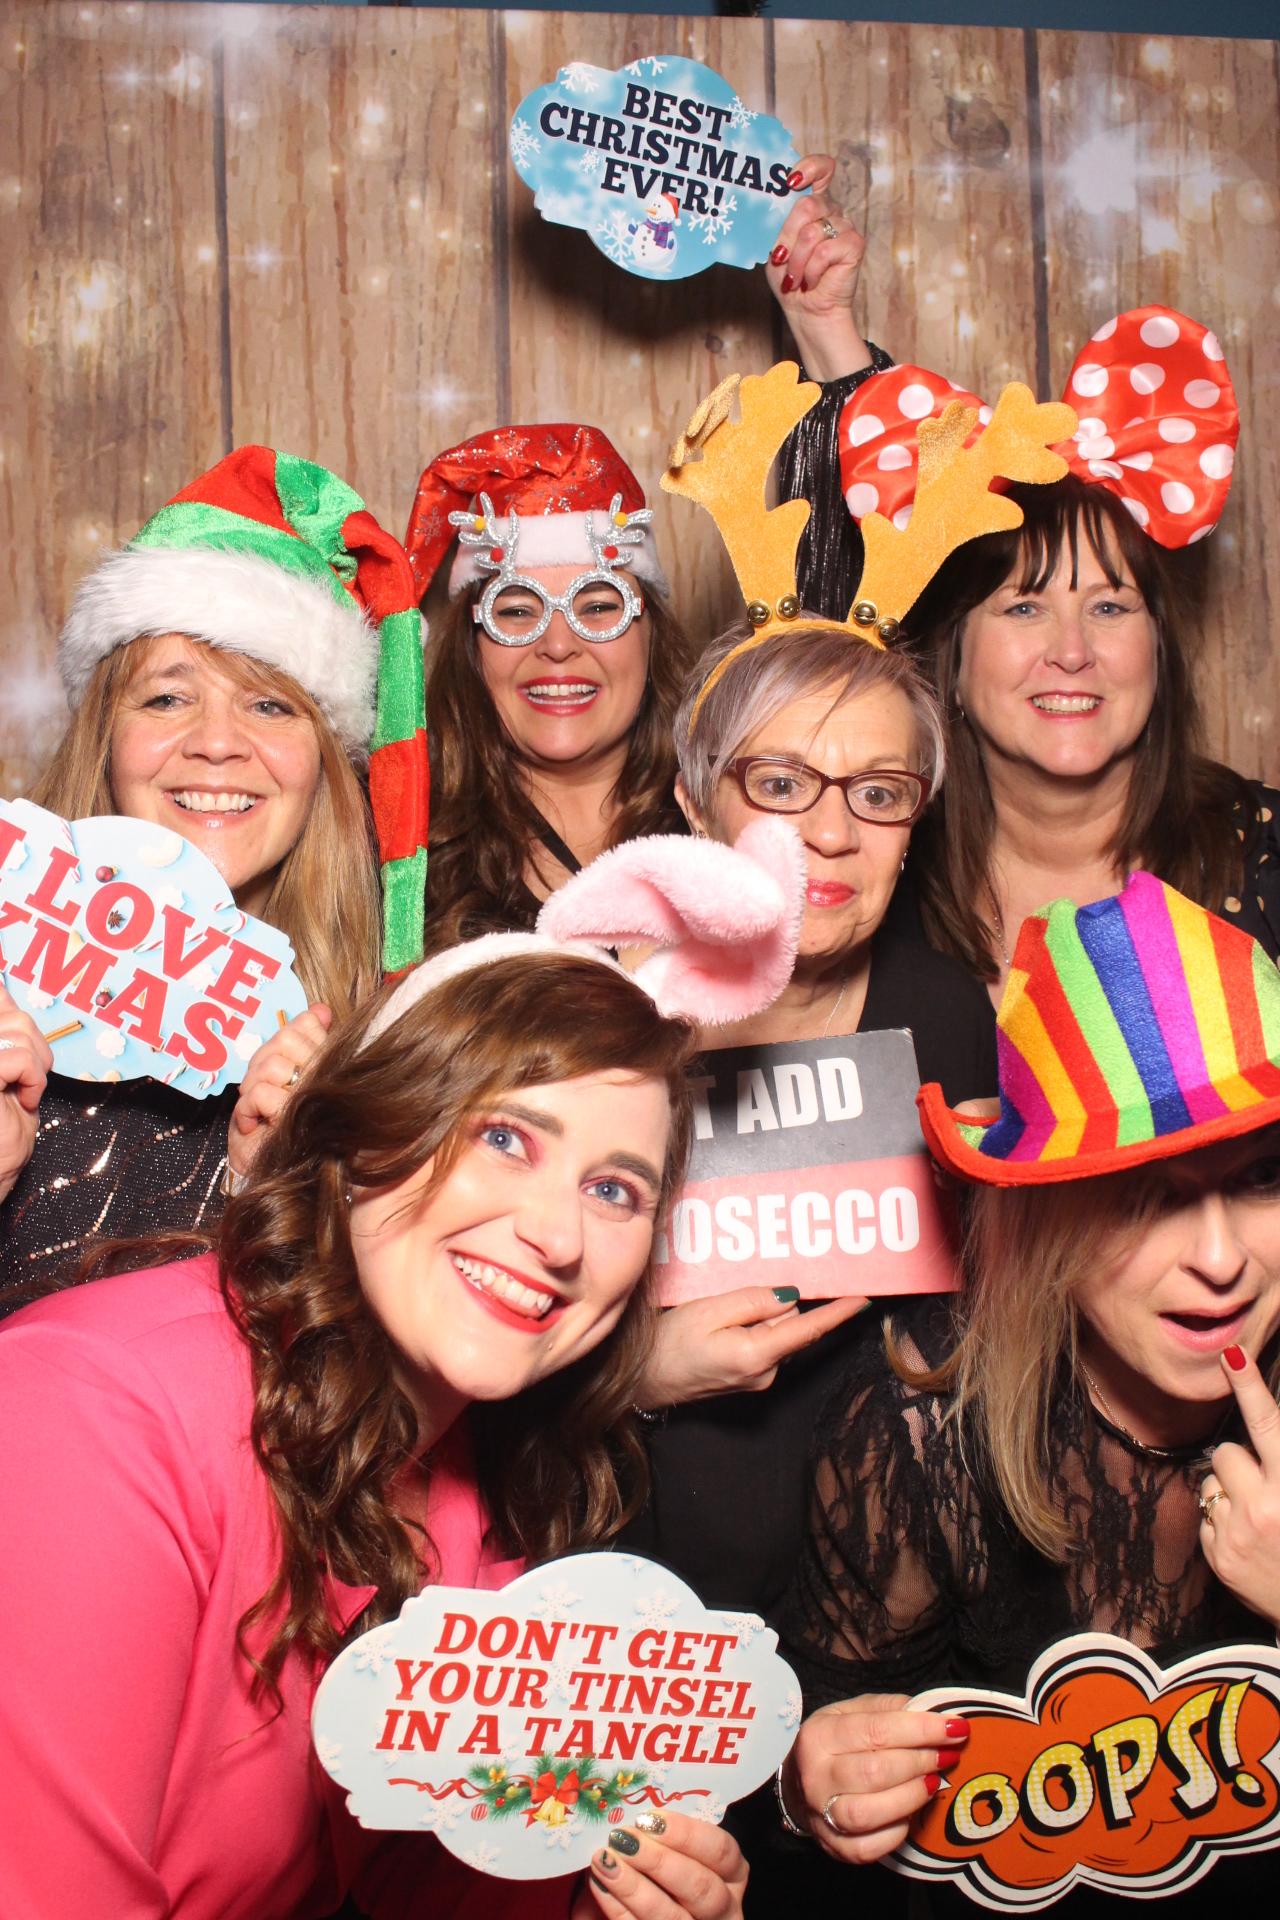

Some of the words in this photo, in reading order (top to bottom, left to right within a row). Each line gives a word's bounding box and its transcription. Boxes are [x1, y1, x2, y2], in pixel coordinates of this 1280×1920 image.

[539, 102, 793, 197] CHRISTMAS
[622, 83, 732, 142] BEST
[25, 846, 282, 1018] LOVE
[736, 1057, 863, 1134] ADD
[653, 1186, 920, 1264] OSECCO
[433, 1613, 619, 1665] DON'T
[627, 1629, 738, 1673] GET
[394, 1659, 548, 1709] YOUR
[568, 1672, 756, 1720] TINSEL
[375, 1710, 450, 1752] IN
[458, 1715, 501, 1755] A
[524, 1717, 748, 1765] TANGLE
[947, 1677, 1264, 1843] OOPS!
